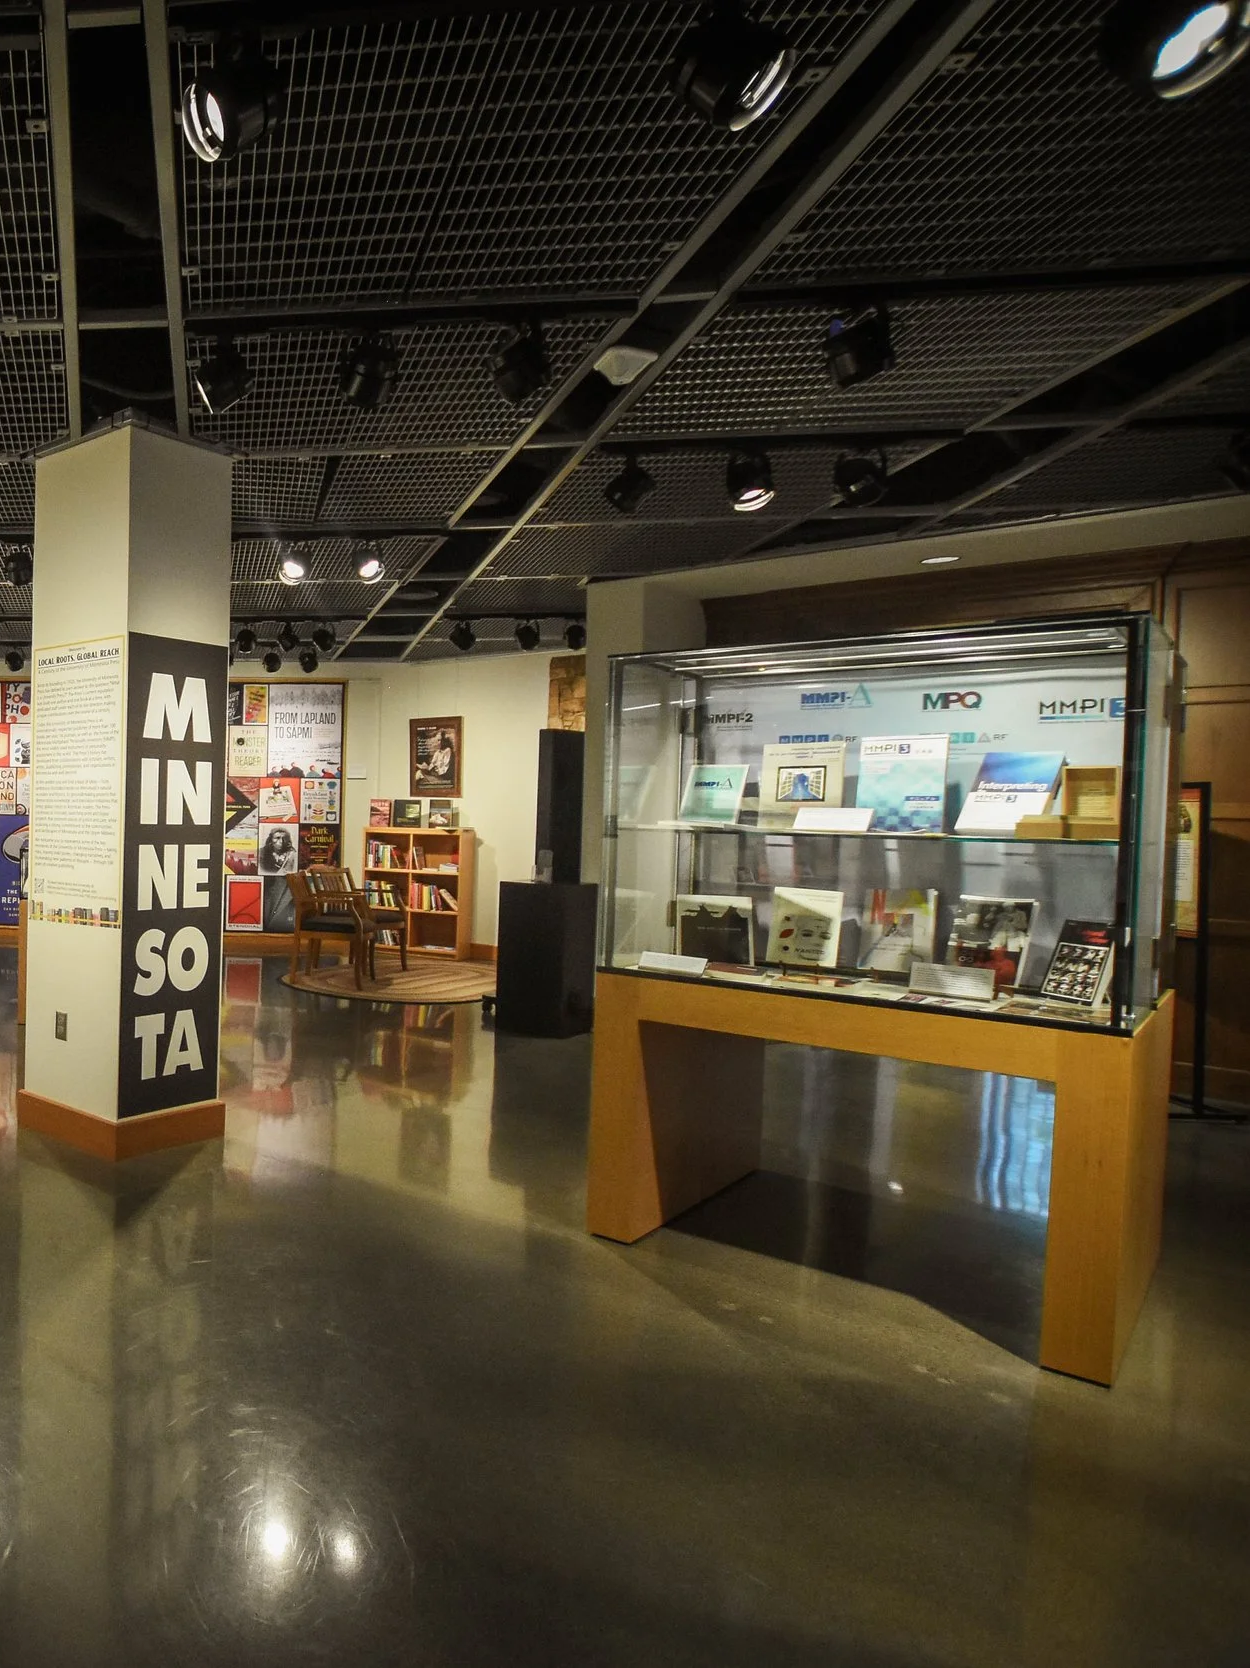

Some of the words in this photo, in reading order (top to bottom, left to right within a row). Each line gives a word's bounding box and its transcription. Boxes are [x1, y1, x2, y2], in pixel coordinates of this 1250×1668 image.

[38, 658, 54, 667] LOCAL
[76, 651, 98, 661] GLOBAL
[100, 648, 120, 657] REACH
[800, 682, 872, 706] MMPI-A
[922, 690, 982, 710] MPQ
[142, 672, 212, 744] M
[1039, 698, 1105, 715] MMPI
[274, 712, 298, 724] FROM
[300, 712, 336, 724] LAPLAND
[274, 726, 284, 738] TO
[232, 737, 266, 747] MONSTER
[864, 744, 898, 753] MMPI
[899, 744, 910, 754] 3
[235, 756, 262, 766] READER
[140, 758, 212, 825] IN
[978, 780, 1048, 792] Interpreting
[305, 834, 334, 843] Carnival
[311, 826, 328, 834] Dark
[137, 844, 211, 911] NE
[134, 926, 209, 996] SO
[134, 1009, 204, 1081] TA
